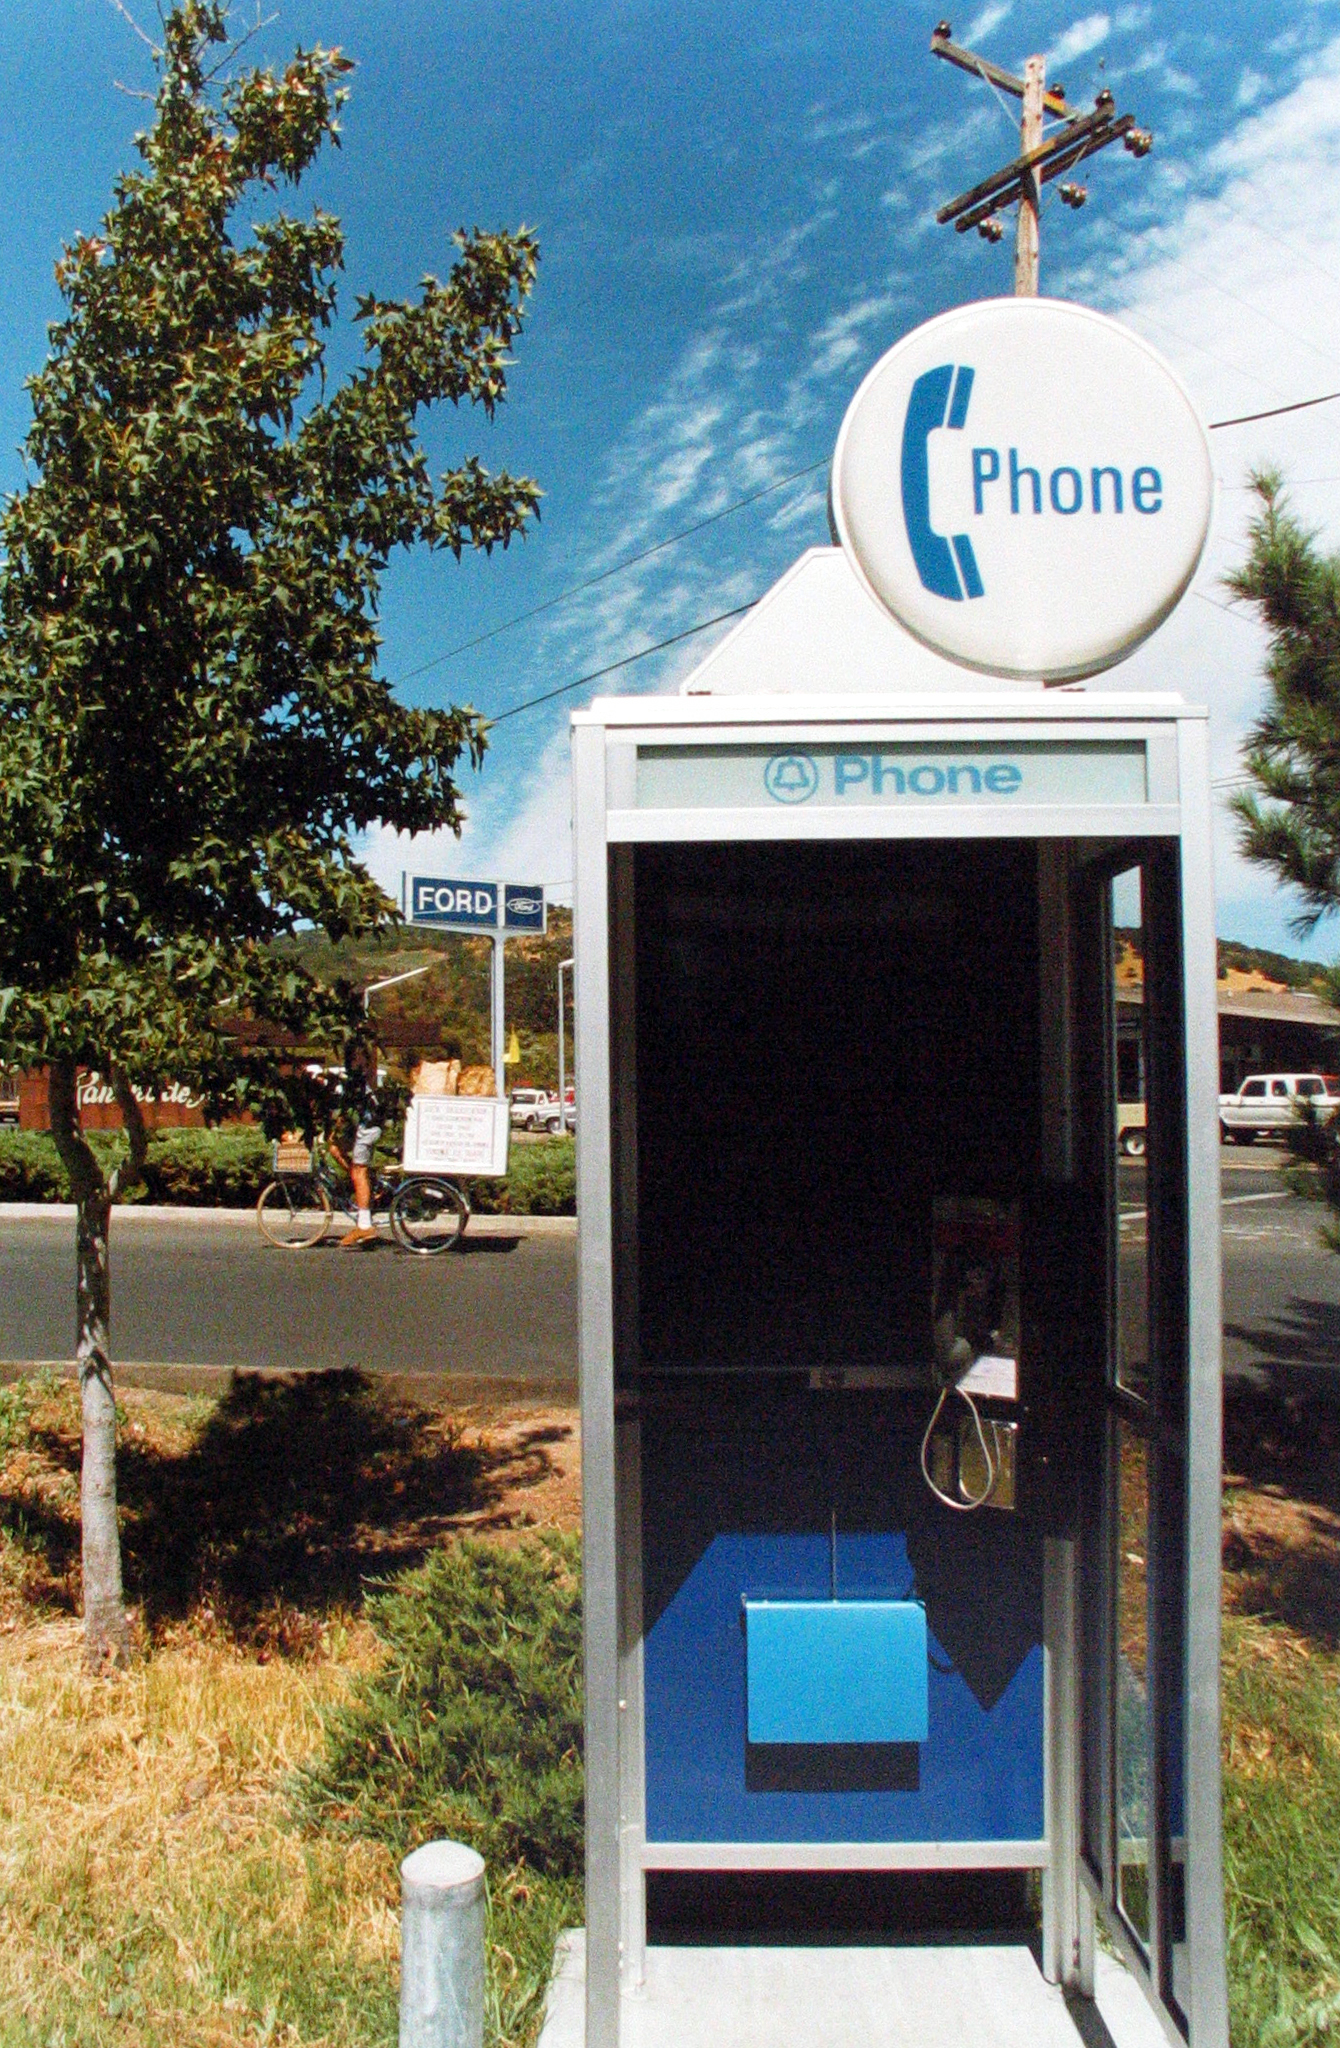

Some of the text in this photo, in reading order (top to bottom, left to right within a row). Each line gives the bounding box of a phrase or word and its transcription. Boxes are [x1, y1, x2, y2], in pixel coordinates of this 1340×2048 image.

[971, 447, 1163, 515] Phone
[834, 753, 1023, 795] Phone
[418, 886, 493, 915] FORD
